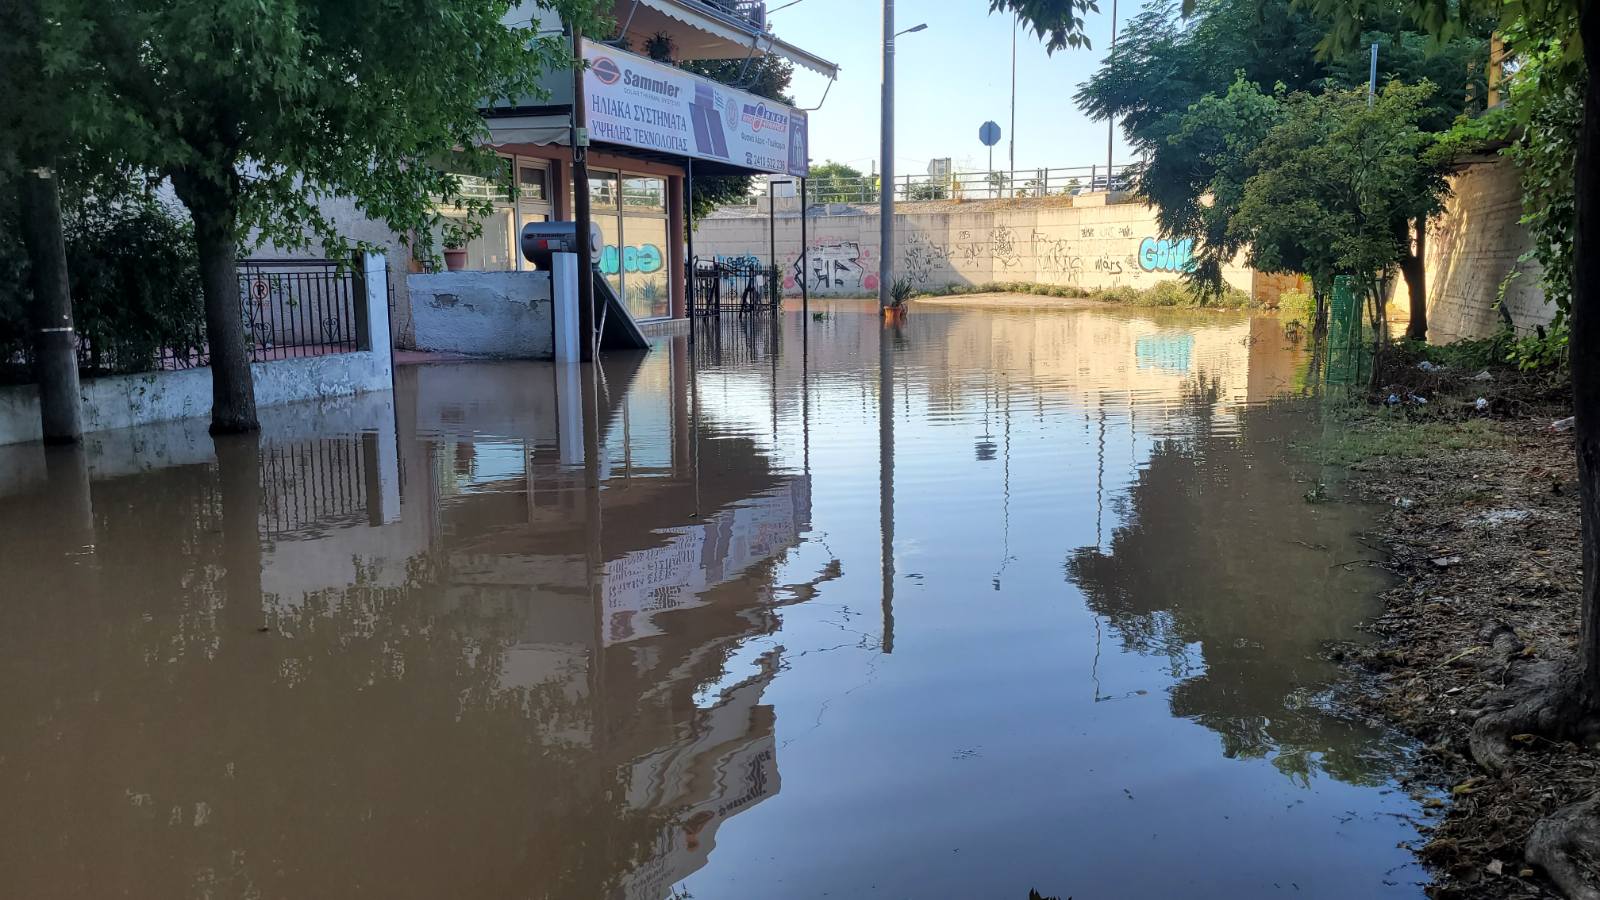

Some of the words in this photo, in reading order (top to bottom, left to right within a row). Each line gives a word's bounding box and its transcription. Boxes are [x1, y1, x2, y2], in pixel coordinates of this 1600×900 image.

[624, 69, 680, 98] Sammler
[592, 95, 631, 120] ΗΛΙΑΚΑ
[634, 104, 687, 132] ΣΥΣΤΗΜΑΤΑ
[592, 120, 631, 141] ΥΨΗΛΗΣ
[634, 128, 688, 152] ΤΕΧΝΟΛΟΓΙΑΣ
